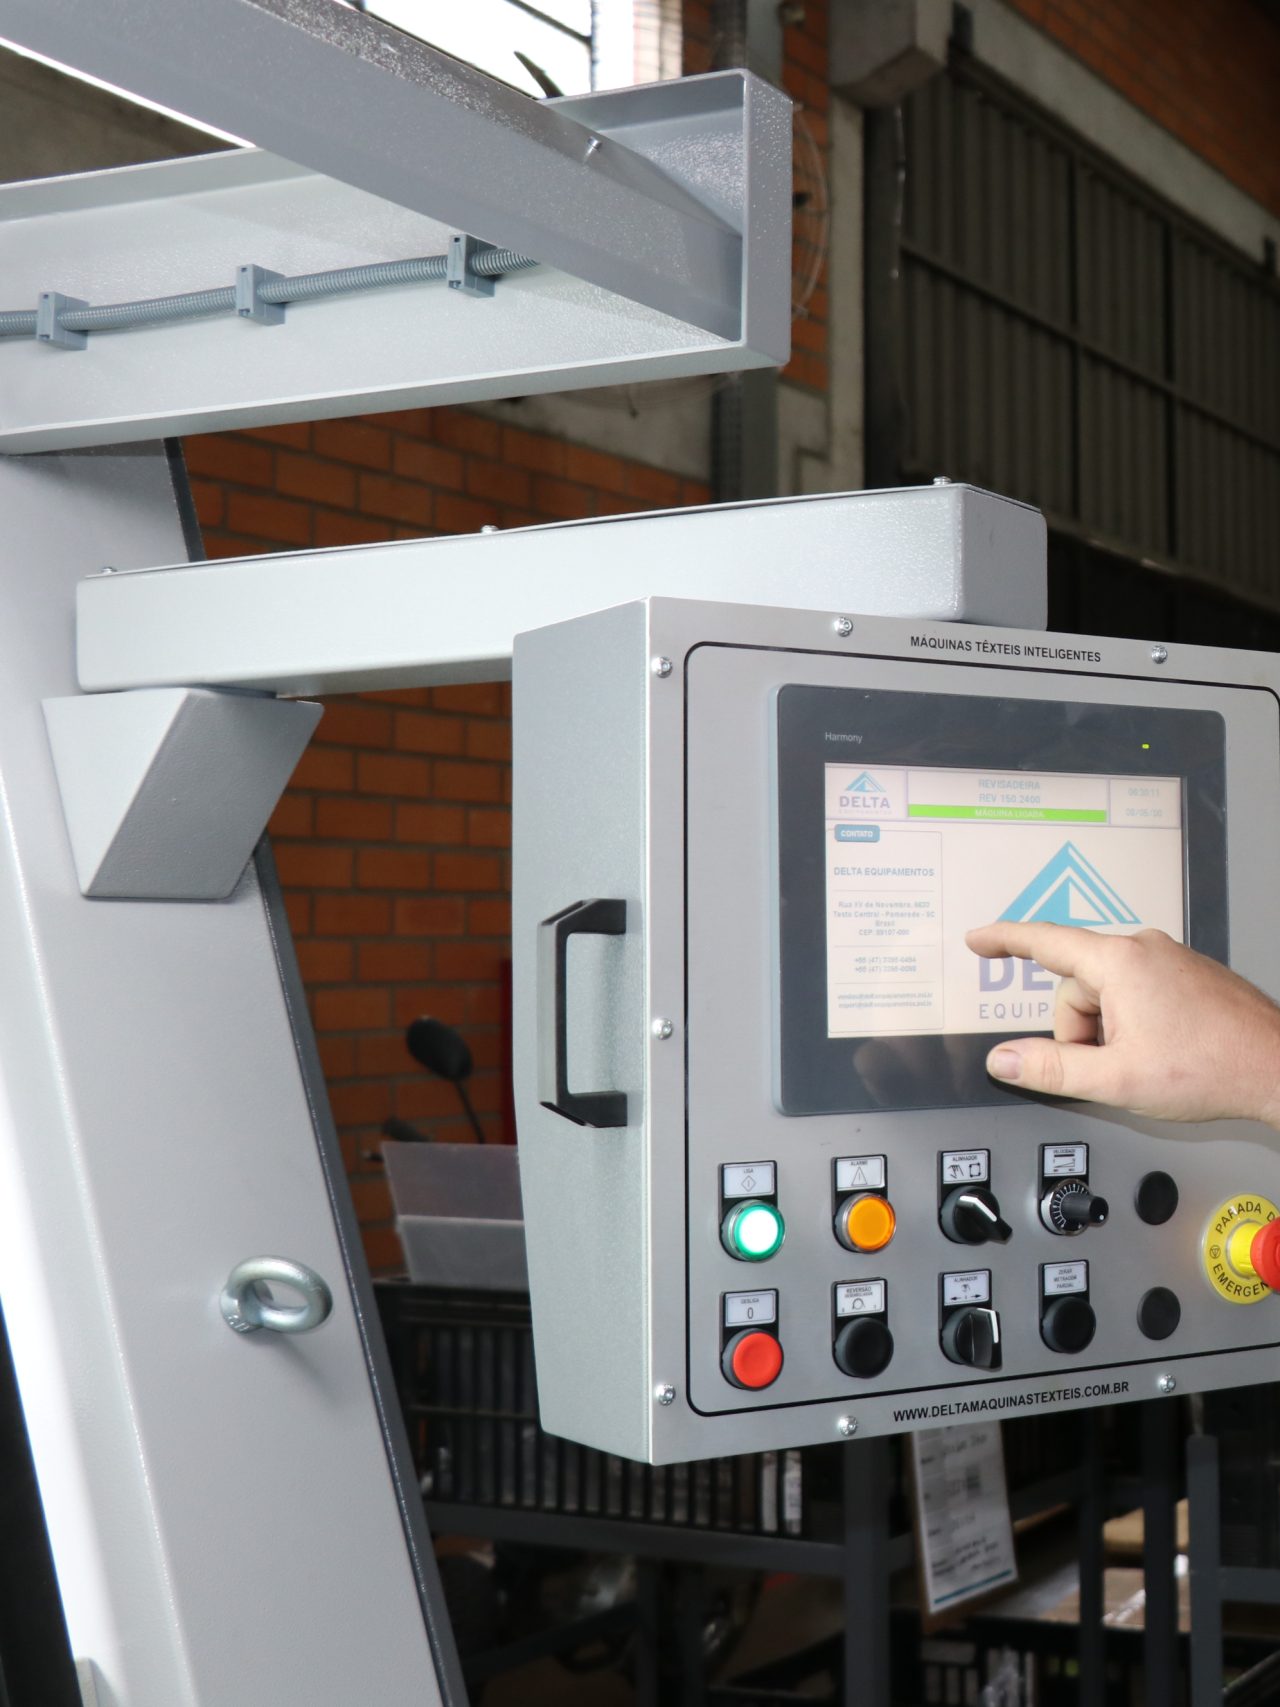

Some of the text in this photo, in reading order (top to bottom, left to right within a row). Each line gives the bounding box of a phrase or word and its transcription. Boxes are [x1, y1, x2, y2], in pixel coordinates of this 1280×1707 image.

[910, 634, 1101, 663] MÁQUINAS TÊXTEIS INTELIGENTES
[825, 731, 863, 744] Harmony
[978, 779, 1040, 791] REVISADEIRA
[839, 796, 891, 809] DELTA
[979, 793, 997, 803] REV
[840, 830, 874, 838] CONTATO
[833, 867, 935, 877] DELTA EQUIPAMENTOS
[979, 956, 1054, 992] DE
[979, 1002, 1056, 1019] EQUIP
[1216, 1201, 1262, 1234] PARADA
[1213, 1263, 1270, 1297] EMERGEN
[893, 1381, 1129, 1423] WWW.DELTAMAQUINASTEXTEIS.COM.BR
